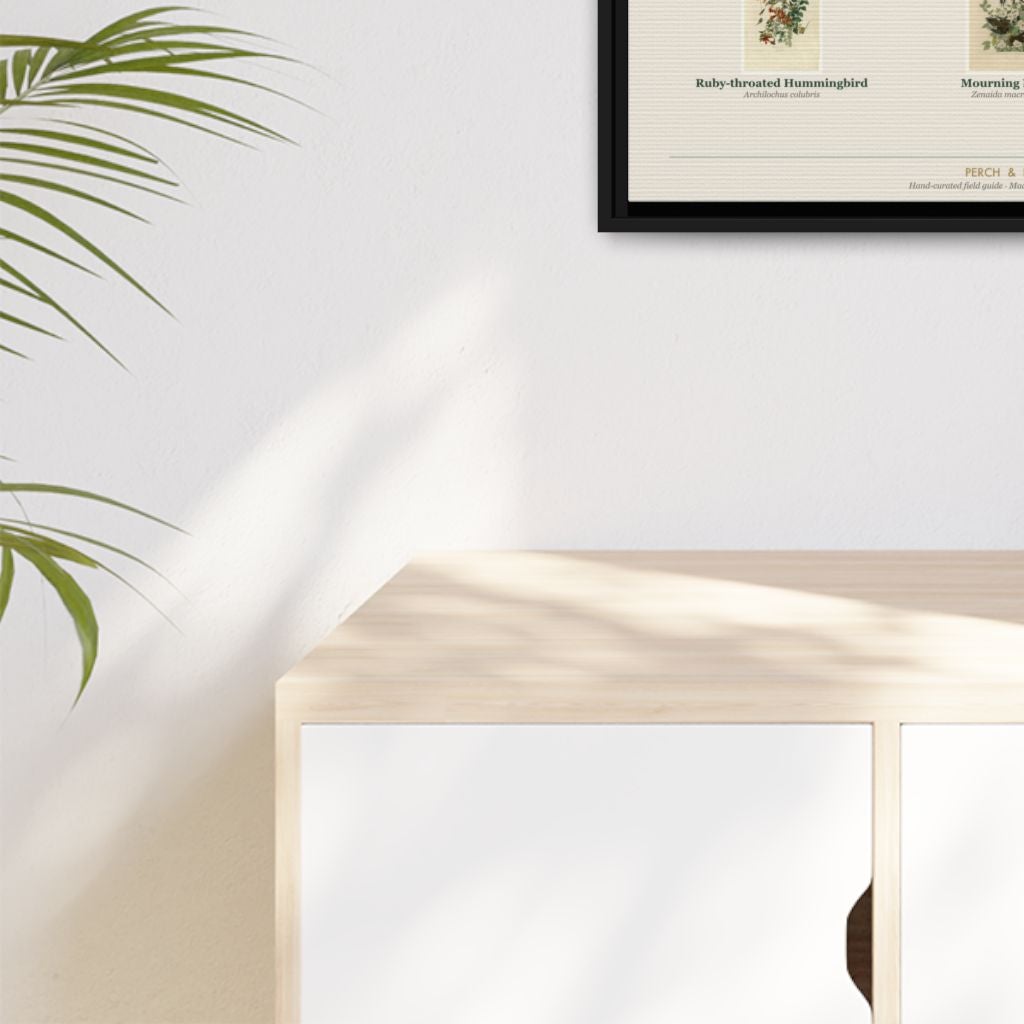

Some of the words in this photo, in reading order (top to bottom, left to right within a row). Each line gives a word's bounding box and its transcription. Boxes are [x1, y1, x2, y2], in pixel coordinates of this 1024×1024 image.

[696, 78, 781, 90] Ruby-throated
[784, 78, 868, 90] Hummingbird
[961, 78, 1020, 90] Mourning
[965, 167, 1000, 177] PERCH
[1008, 167, 1016, 177] &
[908, 181, 962, 190] Hand-curated
[962, 181, 981, 191] field
[982, 181, 1002, 192] guide
